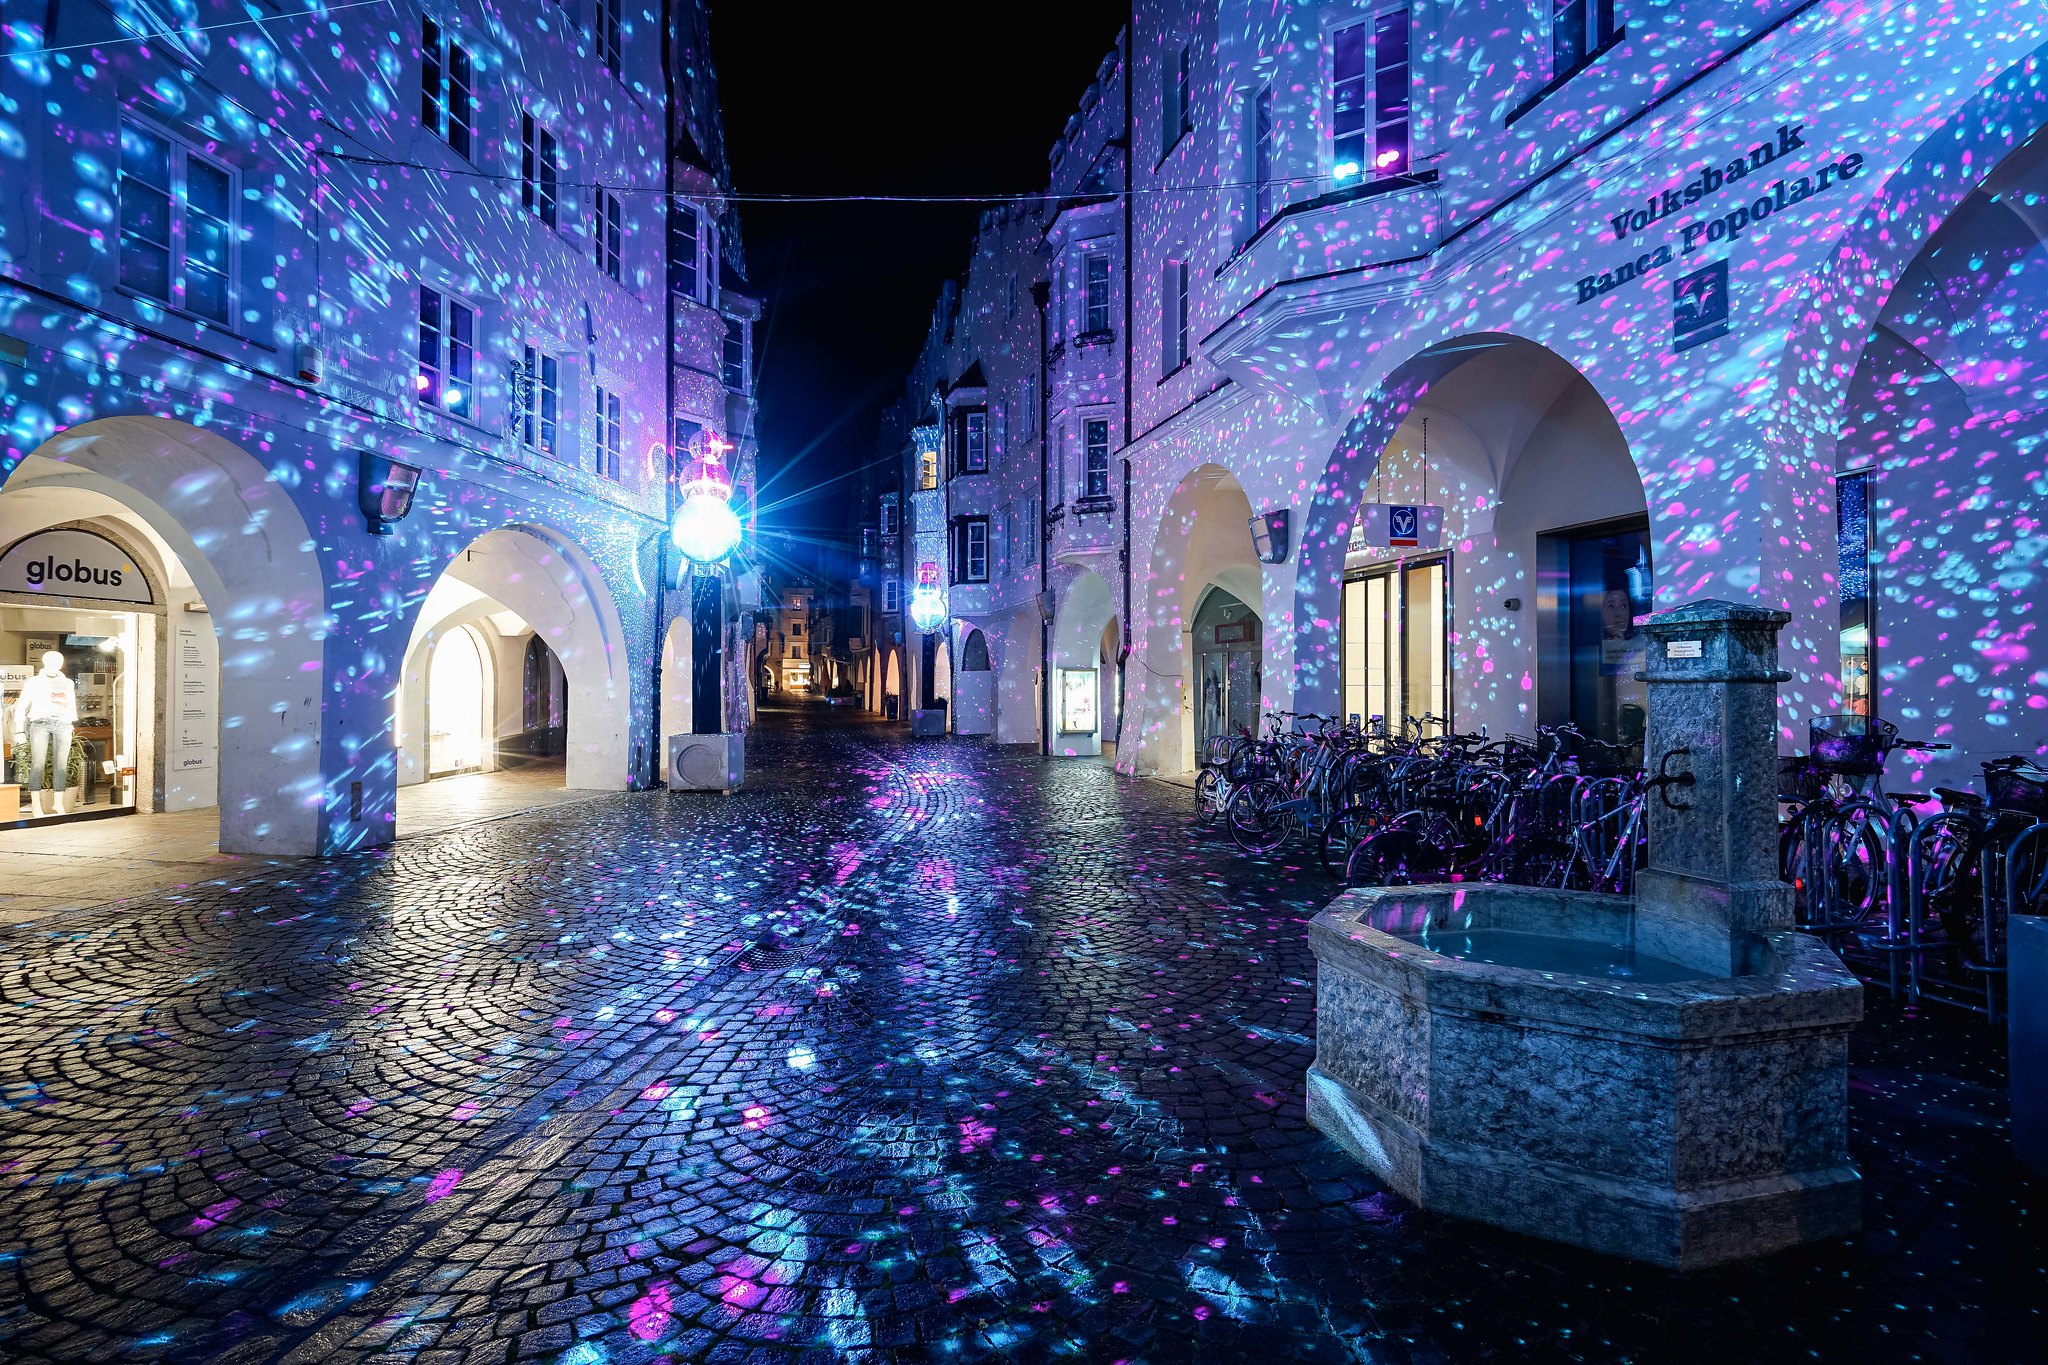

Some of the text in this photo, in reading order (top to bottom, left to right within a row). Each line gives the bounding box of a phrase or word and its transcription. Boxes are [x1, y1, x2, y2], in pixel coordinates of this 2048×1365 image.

[1610, 124, 1805, 240] Volksbank
[1576, 152, 1864, 305] Banca Popolare
[26, 555, 122, 587] globus
[29, 642, 52, 651] globus
[0, 672, 27, 681] obus
[183, 758, 203, 767] globus
